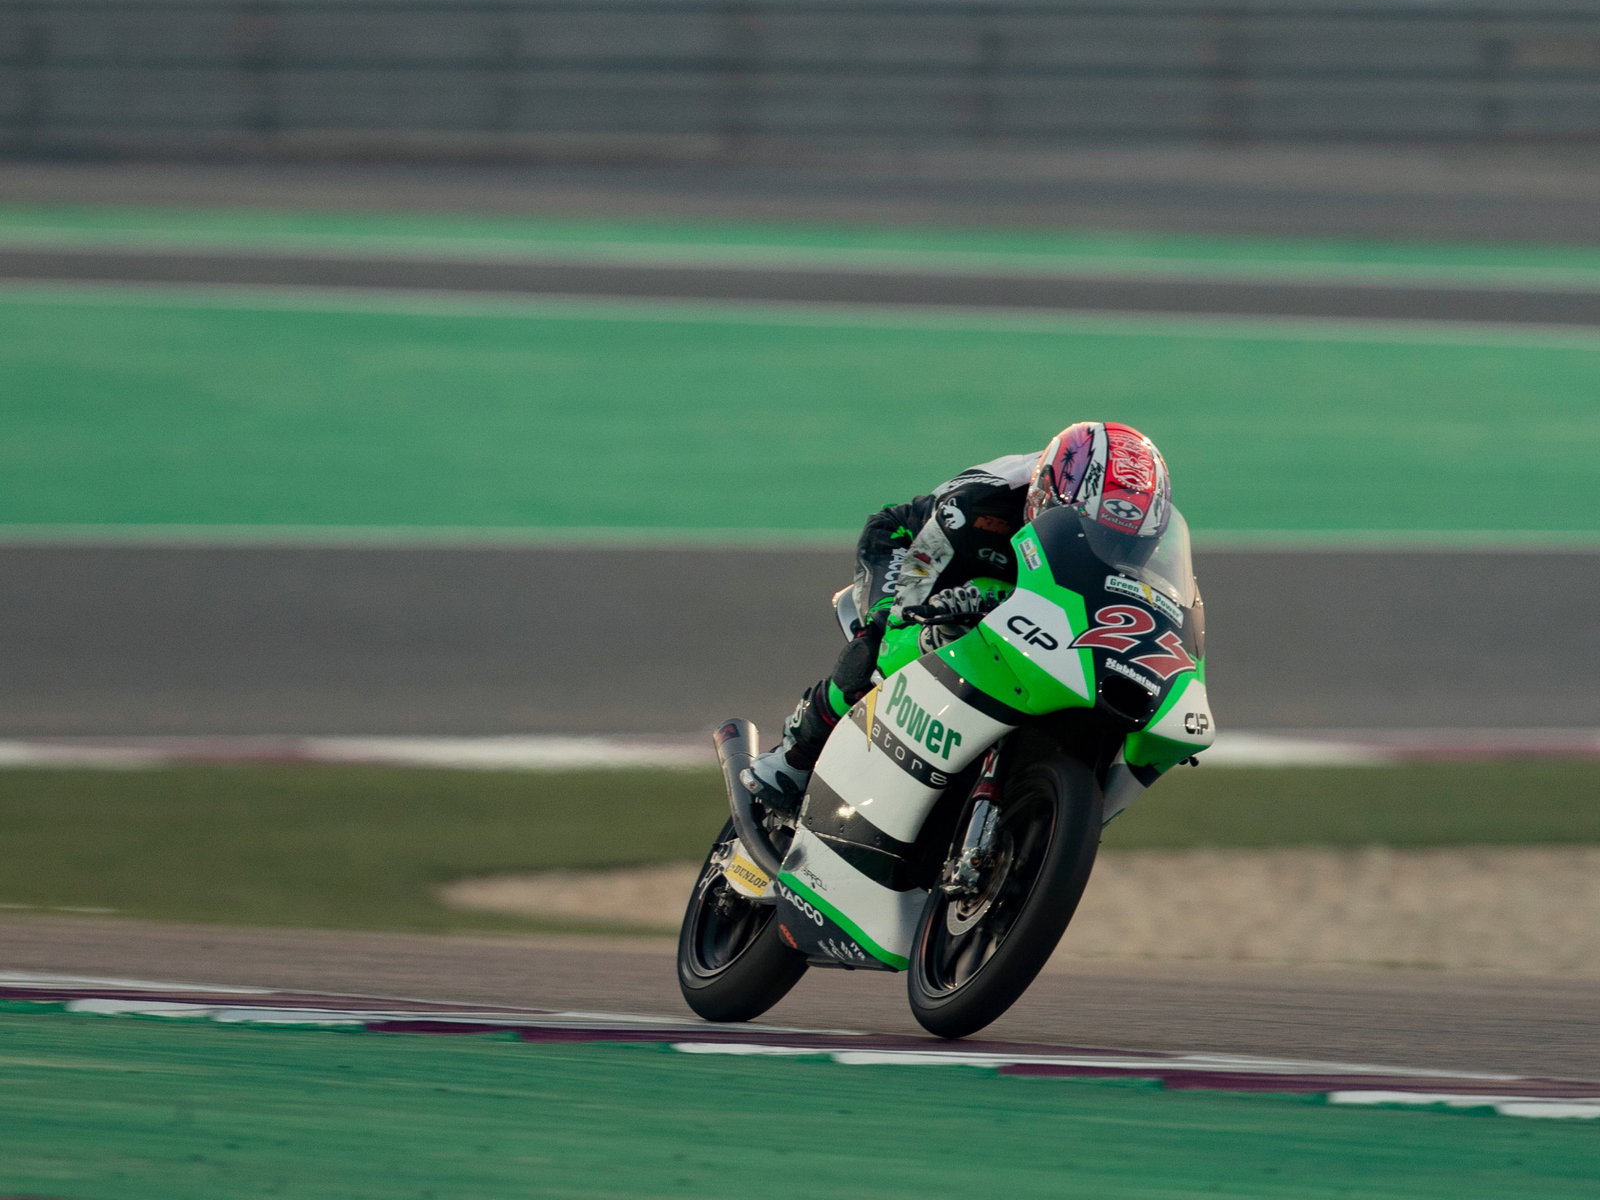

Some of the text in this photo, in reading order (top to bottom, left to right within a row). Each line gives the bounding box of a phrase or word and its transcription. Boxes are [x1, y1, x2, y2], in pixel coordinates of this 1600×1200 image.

[1109, 578, 1140, 593] Green
[1155, 594, 1181, 618] Power
[1007, 615, 1059, 651] CIP
[1070, 604, 1196, 681] 27
[885, 672, 962, 760] Power
[1184, 712, 1209, 735] CIP
[733, 864, 767, 888] DUNLOP
[777, 880, 824, 927] YACCO
